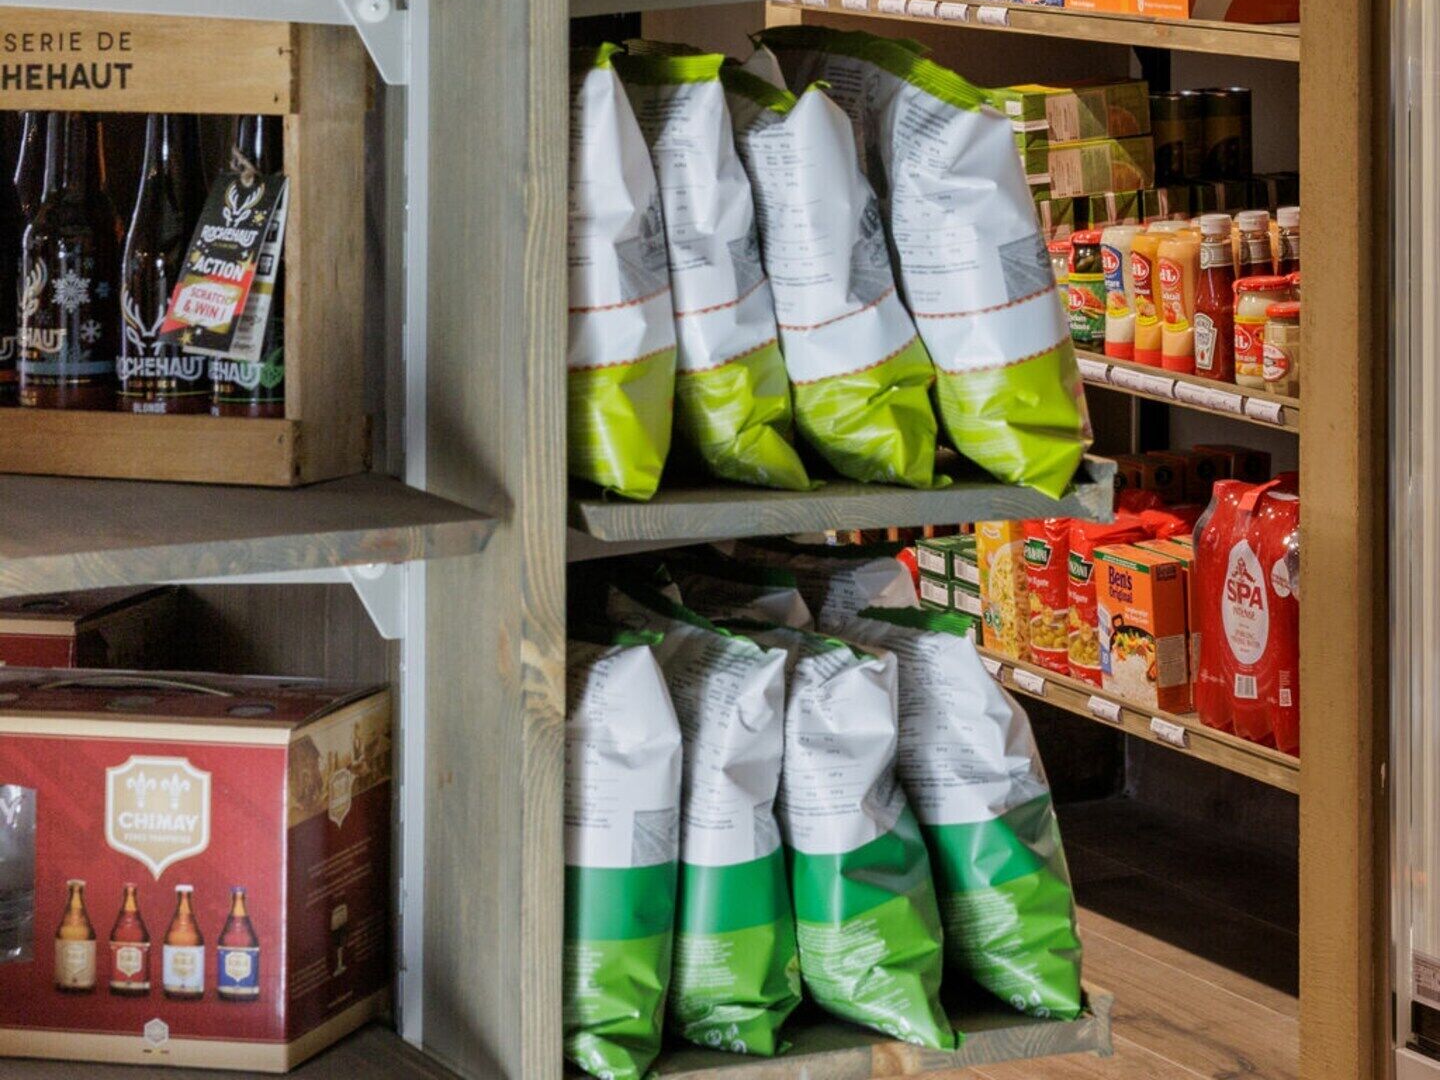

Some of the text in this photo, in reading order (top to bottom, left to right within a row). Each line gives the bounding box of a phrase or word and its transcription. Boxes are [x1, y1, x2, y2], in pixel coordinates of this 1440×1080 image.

[4, 31, 131, 52] SERIE DE
[2, 62, 133, 90] HEHAUT
[193, 255, 246, 283] ACTION
[1108, 565, 1133, 591] Ben's
[1227, 578, 1264, 611] SPA
[119, 810, 199, 833] CHIMAY
